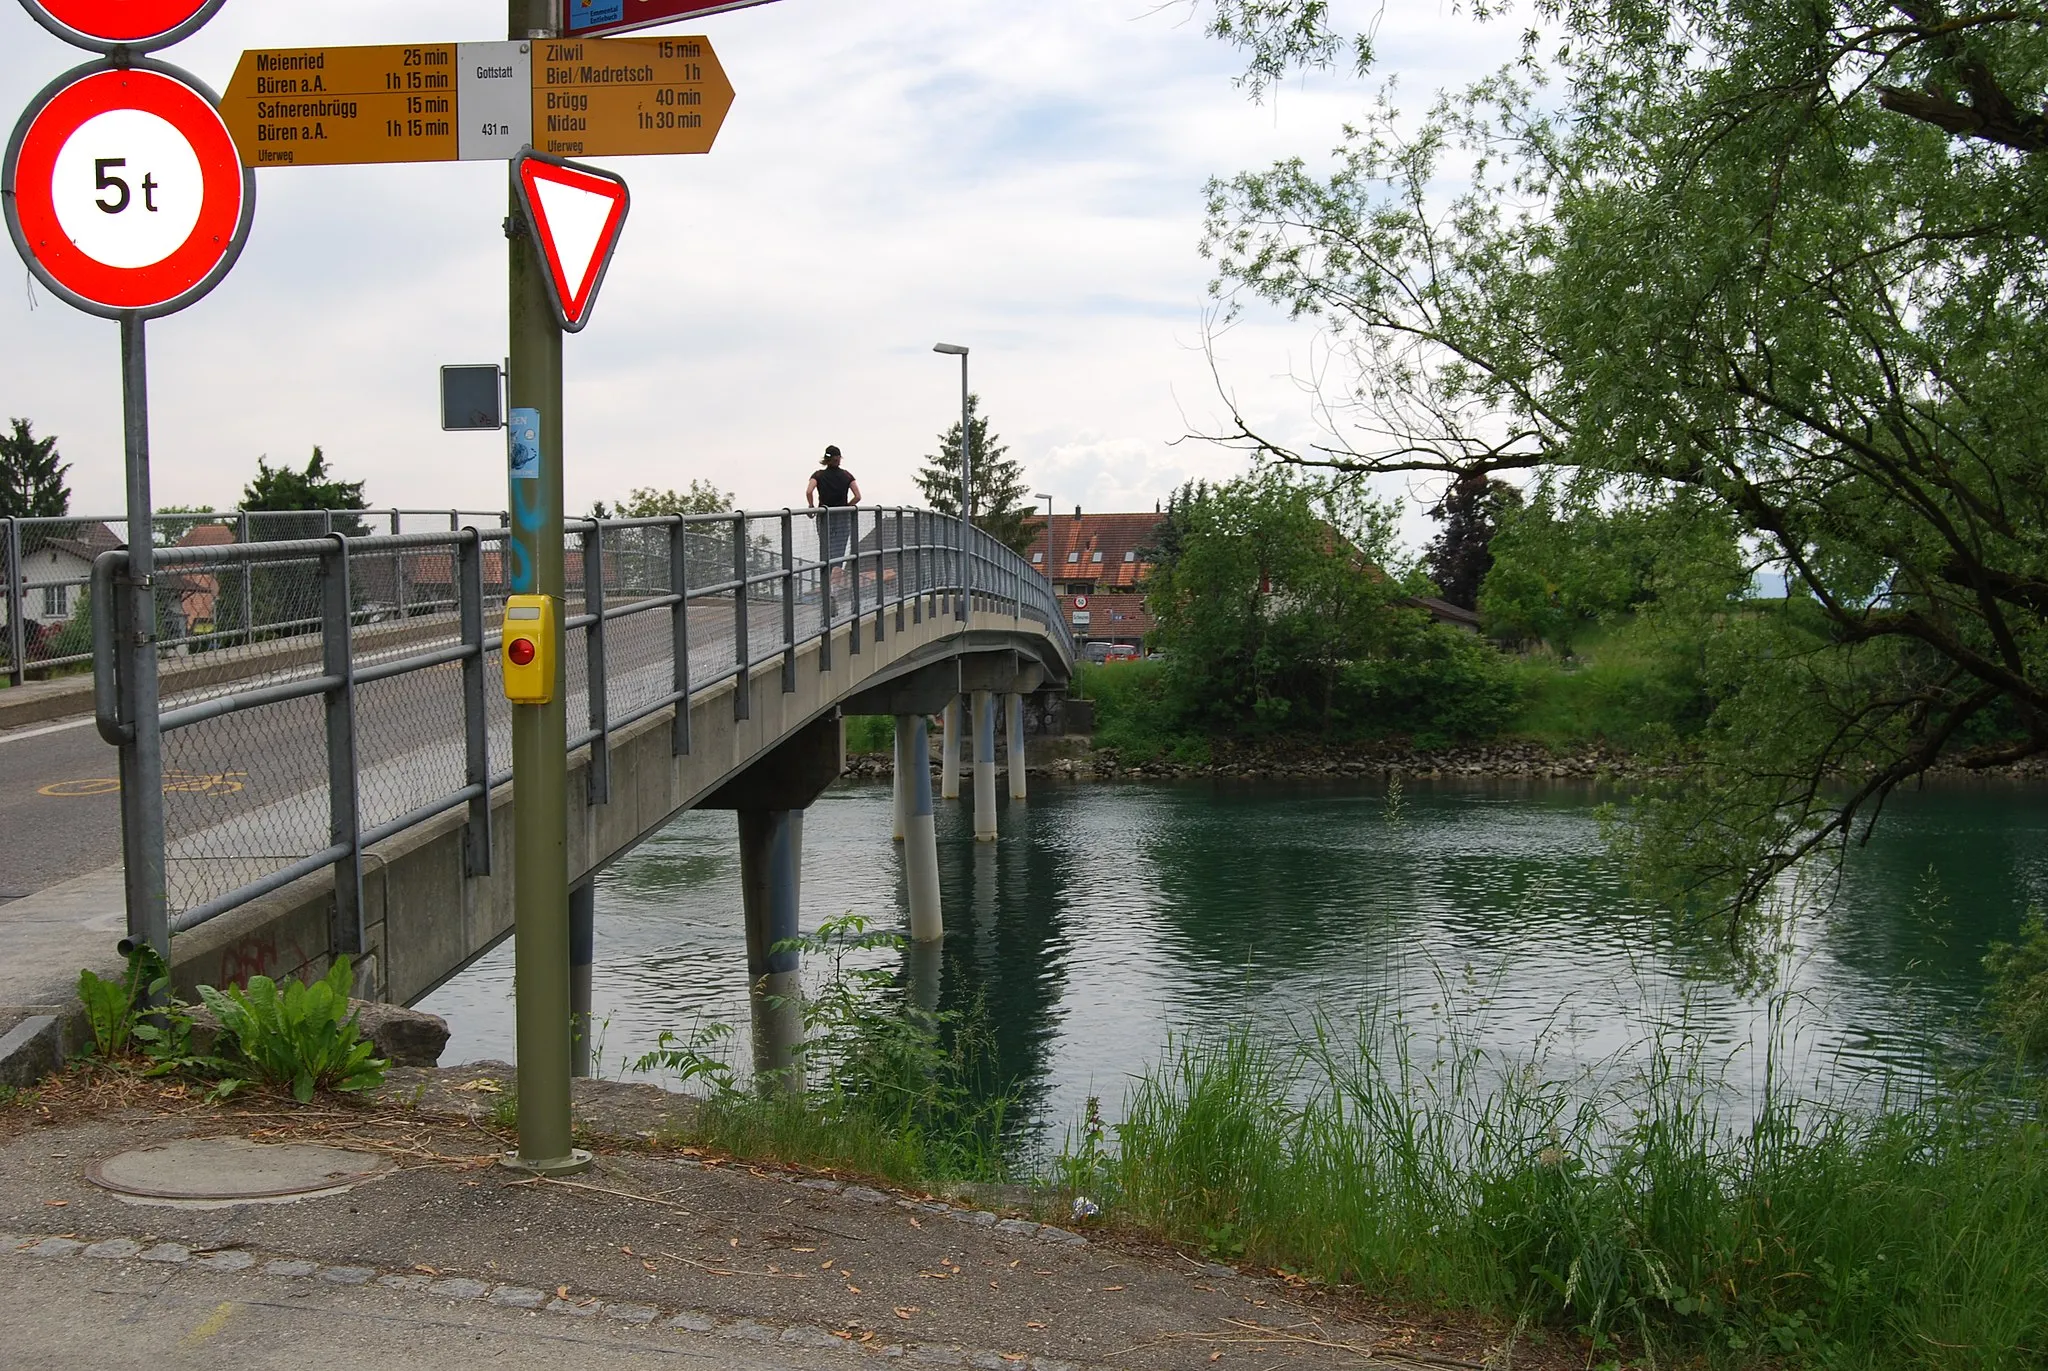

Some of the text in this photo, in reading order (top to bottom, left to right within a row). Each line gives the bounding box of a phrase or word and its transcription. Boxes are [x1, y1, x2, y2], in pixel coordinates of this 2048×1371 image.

[404, 49, 448, 65] 25 min
[547, 45, 583, 61] Zilwil
[659, 41, 700, 58] 15 min
[257, 52, 324, 71] Meienried
[407, 72, 421, 88] 15
[425, 72, 448, 88] min
[477, 66, 513, 79] Gottstatt
[547, 64, 653, 84] Biel/Madretsch
[257, 75, 326, 94] Büren a.A.
[407, 96, 448, 113] 15 min
[547, 92, 587, 111] Brügg
[656, 89, 701, 105] 40 min
[258, 100, 357, 119] Safnerenbrügg
[407, 120, 422, 136] 15
[426, 119, 449, 135] min
[547, 115, 586, 132] Nidau
[656, 112, 674, 129] 30
[678, 111, 701, 128] min
[258, 122, 327, 141] Büren a.A.
[482, 123, 508, 135] 431 m
[547, 140, 583, 152] Uferweg
[259, 149, 293, 163] Uferweg
[94, 158, 158, 214] 5 t
